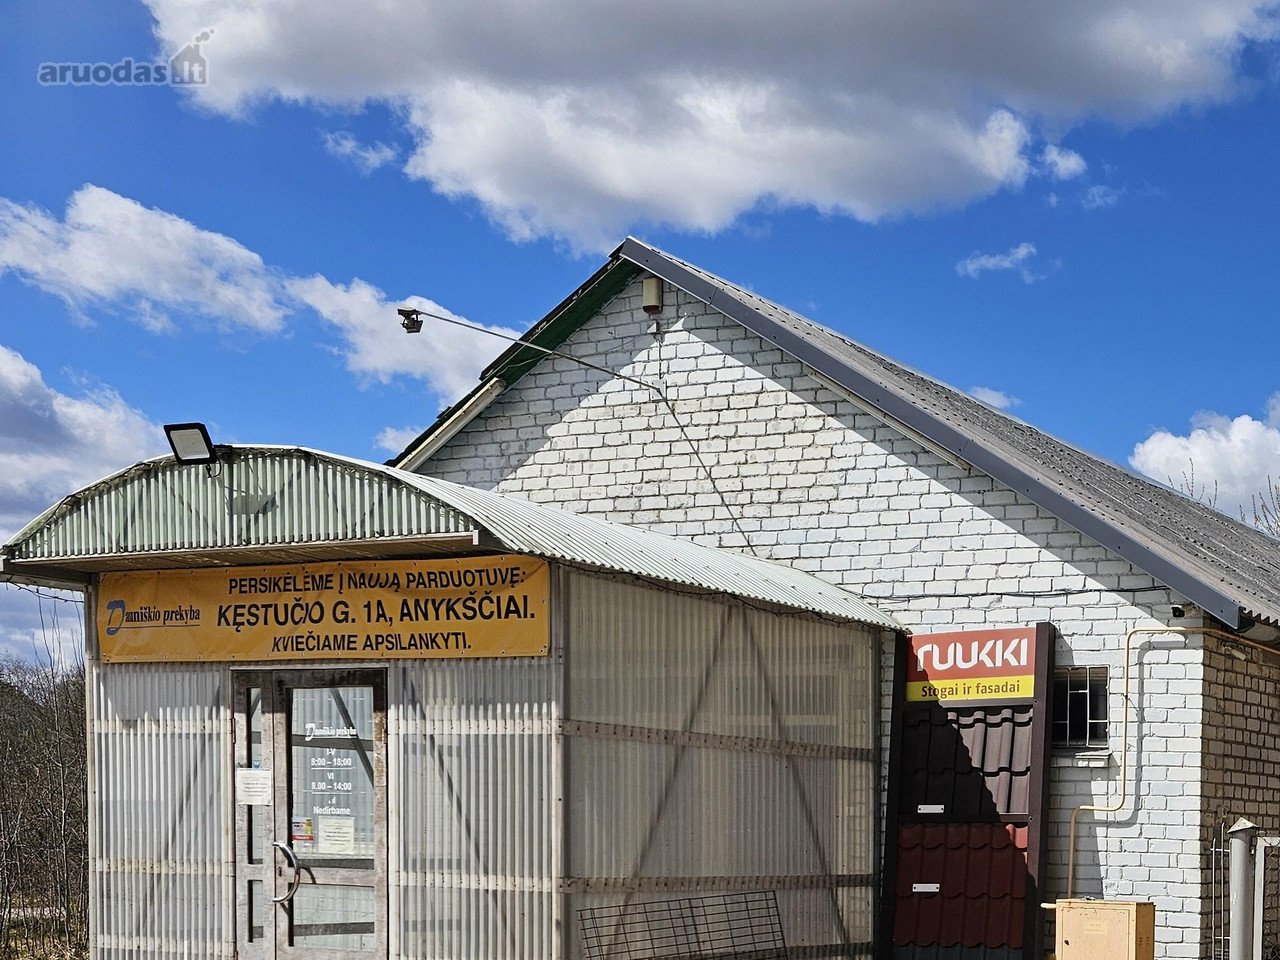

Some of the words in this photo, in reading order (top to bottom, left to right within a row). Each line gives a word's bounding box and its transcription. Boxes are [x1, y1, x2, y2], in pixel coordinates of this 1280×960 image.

[228, 571, 334, 595] PERSIKĖLĖME
[347, 571, 400, 592] NAUJĄ
[163, 605, 200, 625] prekyba
[217, 596, 325, 632] KĘSTUČIO
[331, 600, 356, 624] G.
[363, 599, 393, 626] 1A,
[399, 590, 536, 622] ANYKŠČIAI.
[272, 631, 358, 652] KVIEČIAME
[362, 632, 472, 650] APSILANKYTI.
[921, 683, 958, 699] Stogai
[963, 683, 972, 695] ir
[976, 680, 1020, 694] fasadai
[310, 757, 326, 766] 8:00
[333, 758, 352, 766] 18:00
[333, 782, 352, 790] 14:00
[313, 805, 350, 815] Nedirbame
